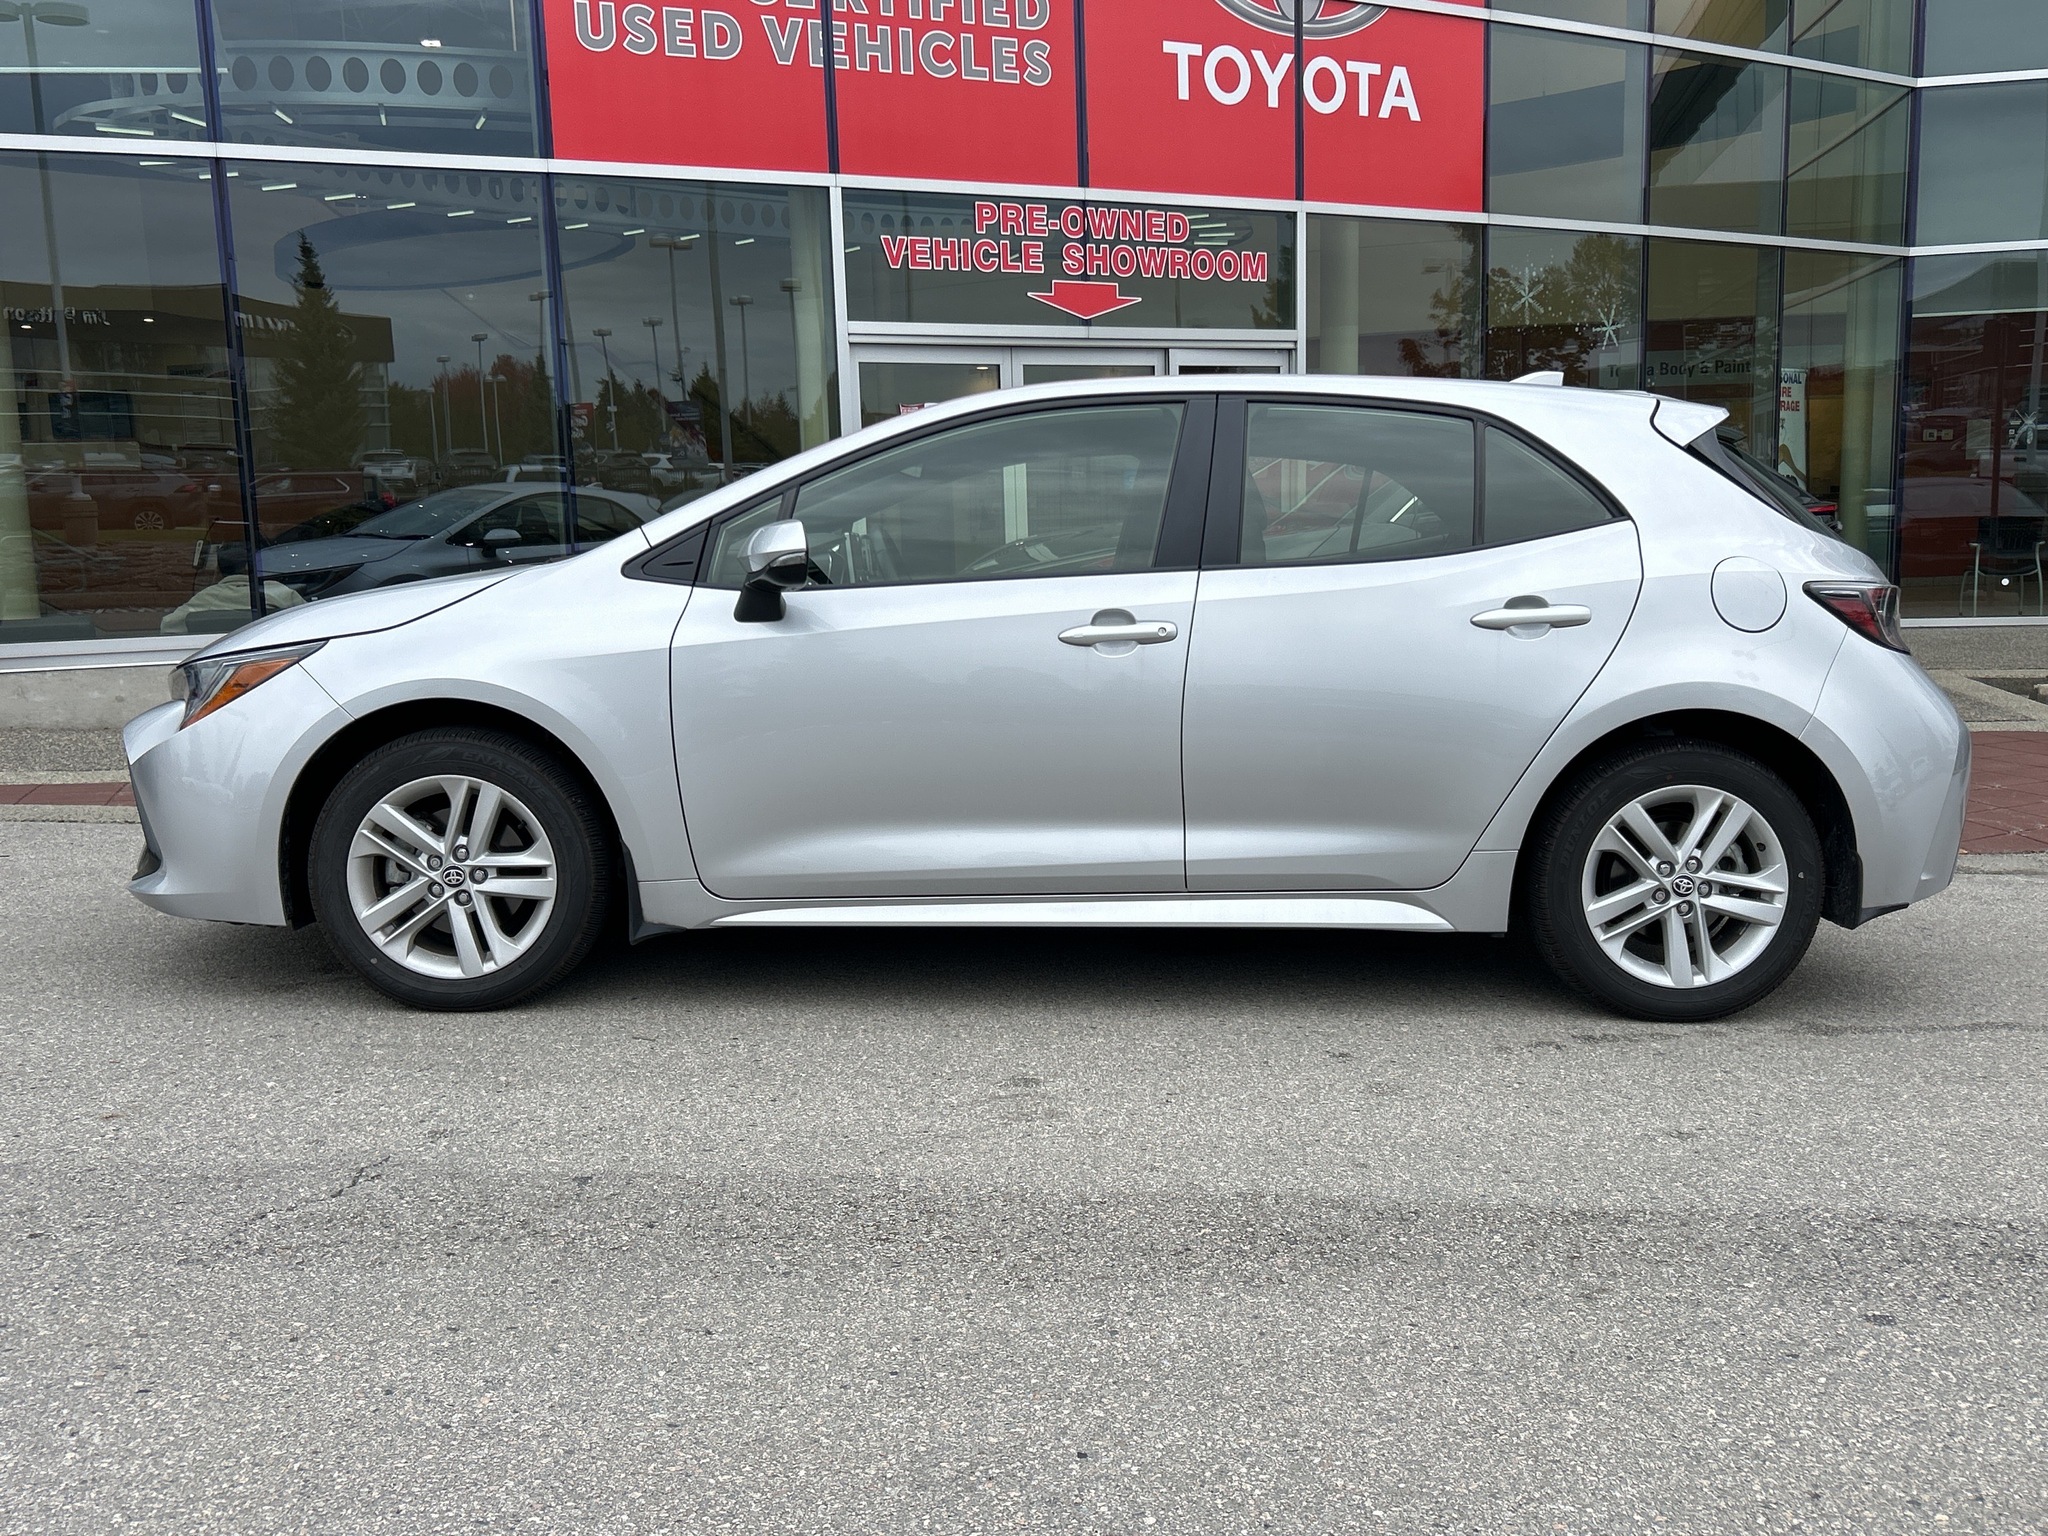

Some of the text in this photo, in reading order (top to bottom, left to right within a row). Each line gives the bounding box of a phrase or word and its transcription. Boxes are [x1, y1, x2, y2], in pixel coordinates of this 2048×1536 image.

[574, 1, 743, 61] USED
[760, 14, 1052, 87] VEHICLES
[1162, 40, 1421, 122] TOYOTA
[975, 201, 1190, 243] PRE-OWNED
[881, 235, 1268, 282] VEHICLE SHOWROOM
[1714, 359, 1751, 374] Paint
